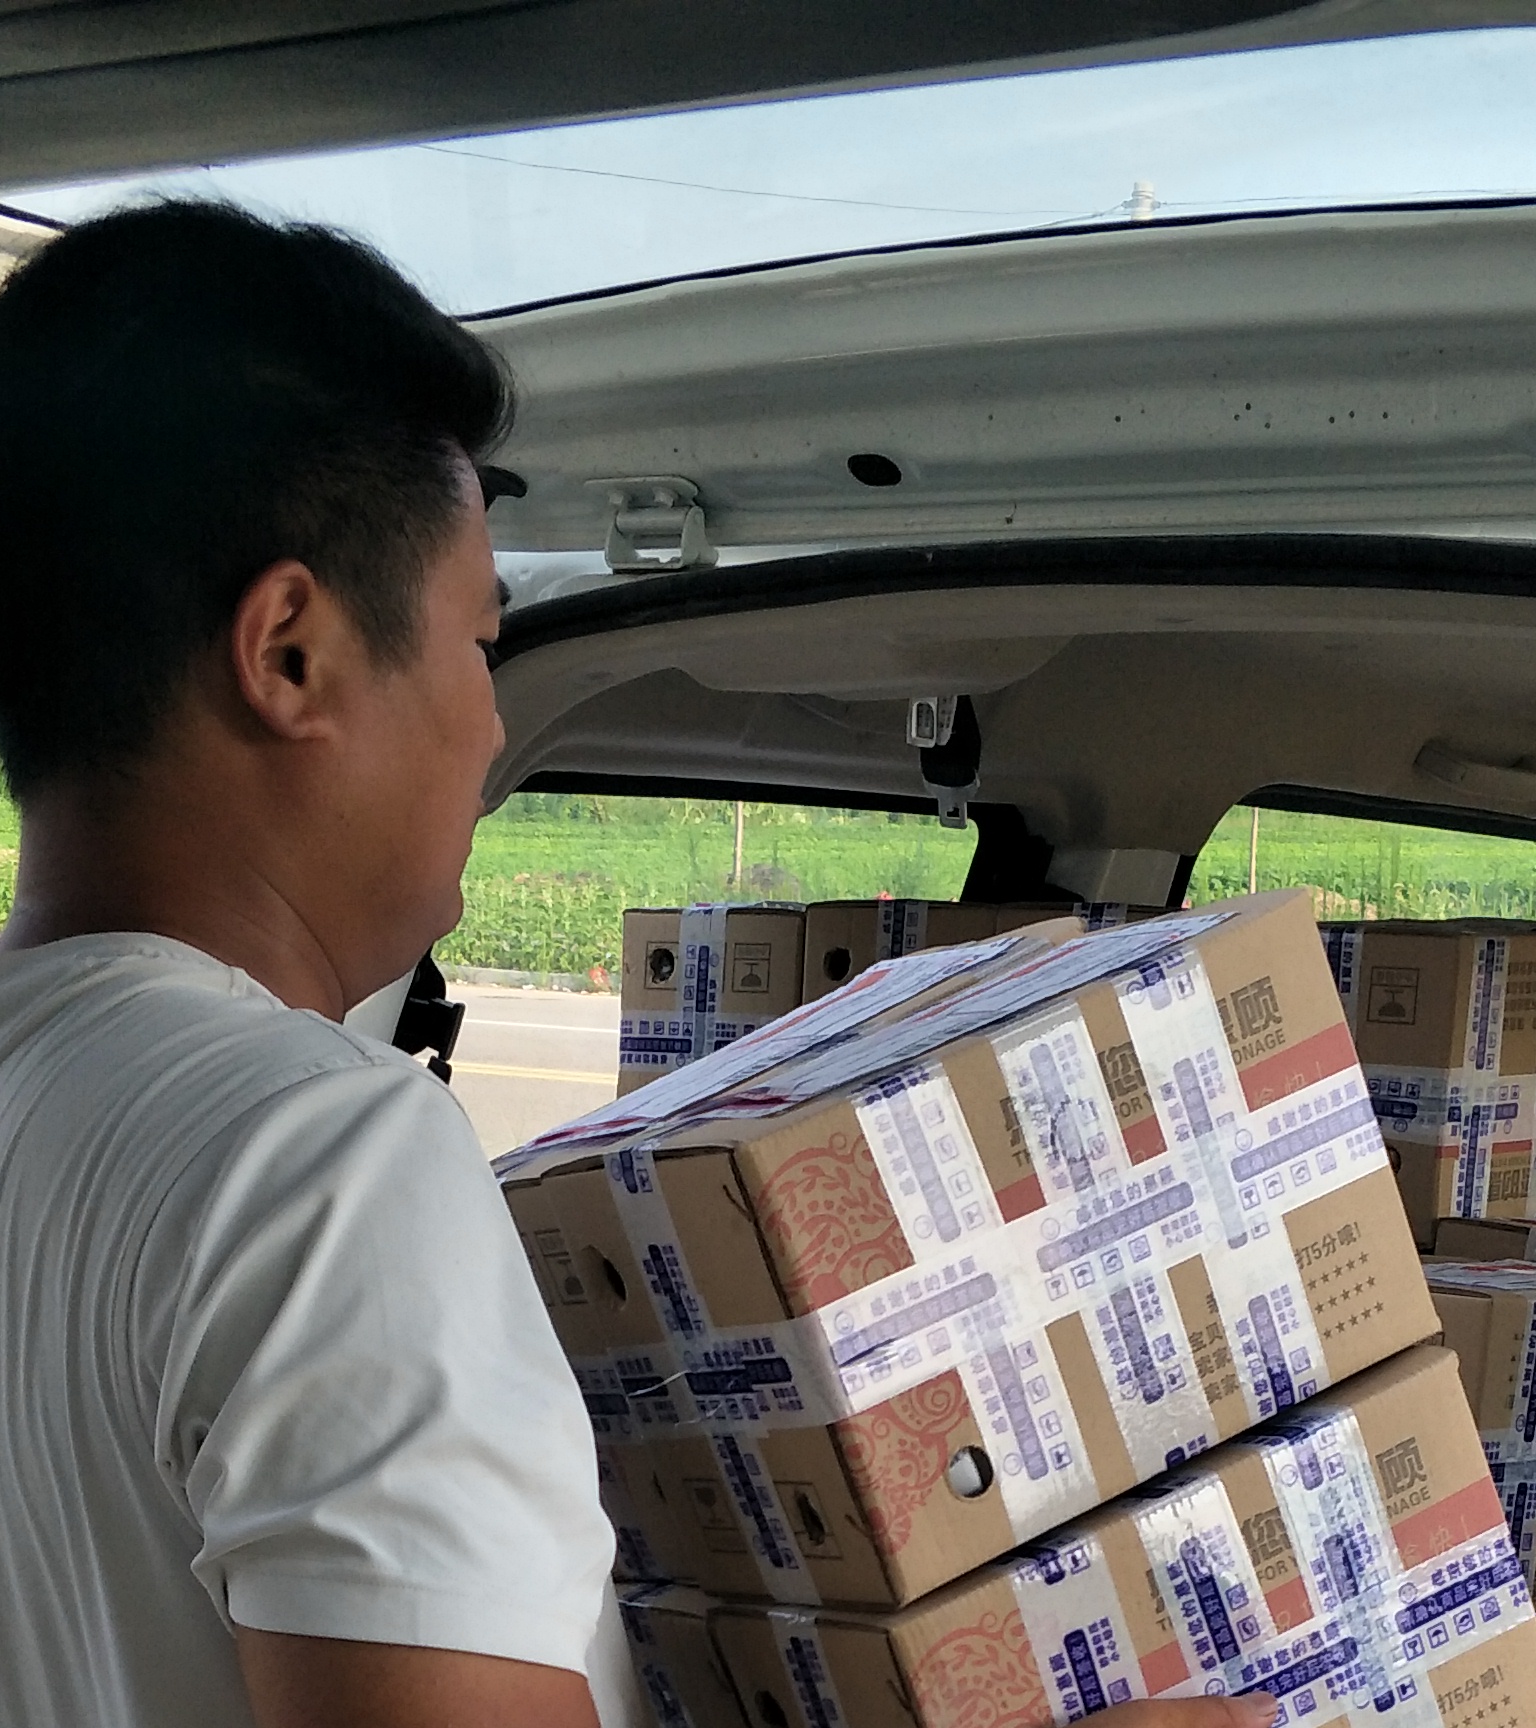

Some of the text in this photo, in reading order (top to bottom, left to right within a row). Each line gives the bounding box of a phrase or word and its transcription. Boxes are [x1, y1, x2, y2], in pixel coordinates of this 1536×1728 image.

[1230, 1028, 1286, 1067] ONAGE
[1241, 1620, 1341, 1683] 感谢您的惠顾
[1437, 1664, 1505, 1716] 打5分哦!
